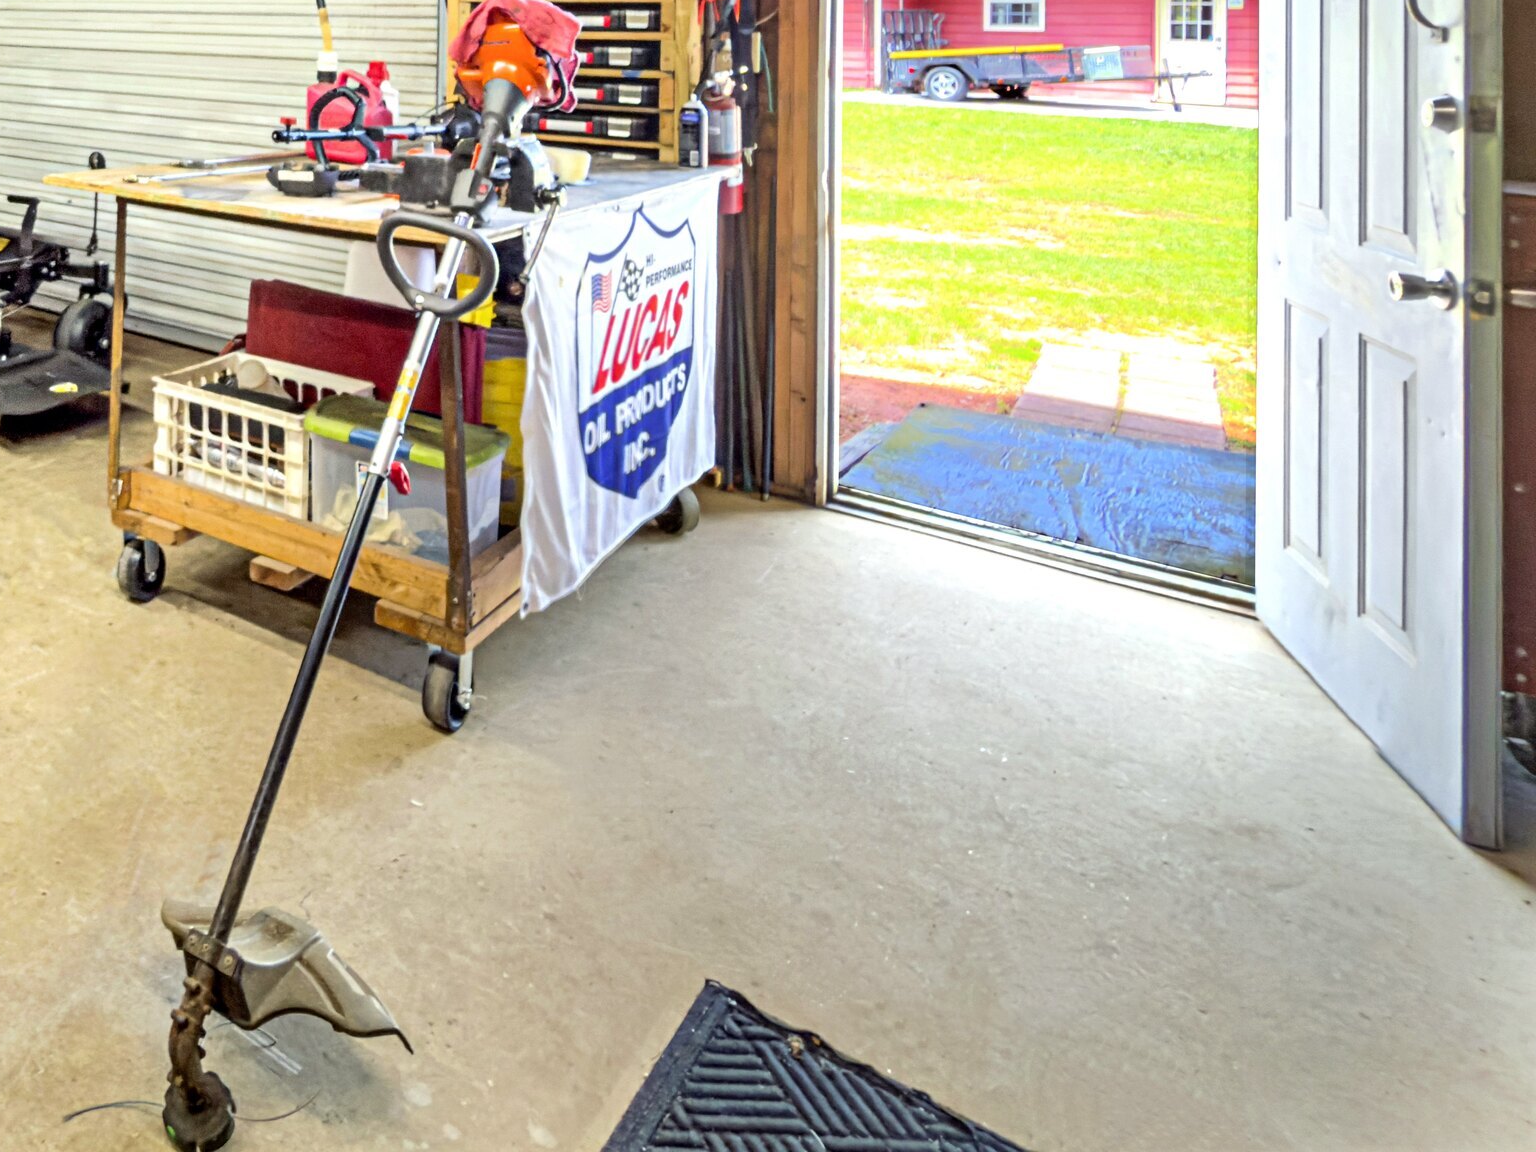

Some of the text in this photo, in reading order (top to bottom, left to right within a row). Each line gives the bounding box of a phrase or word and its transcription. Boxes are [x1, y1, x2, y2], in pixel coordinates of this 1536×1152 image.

[645, 258, 693, 288] PERFORMANCE
[592, 280, 689, 394] LUCAS
[584, 412, 611, 455] OIL
